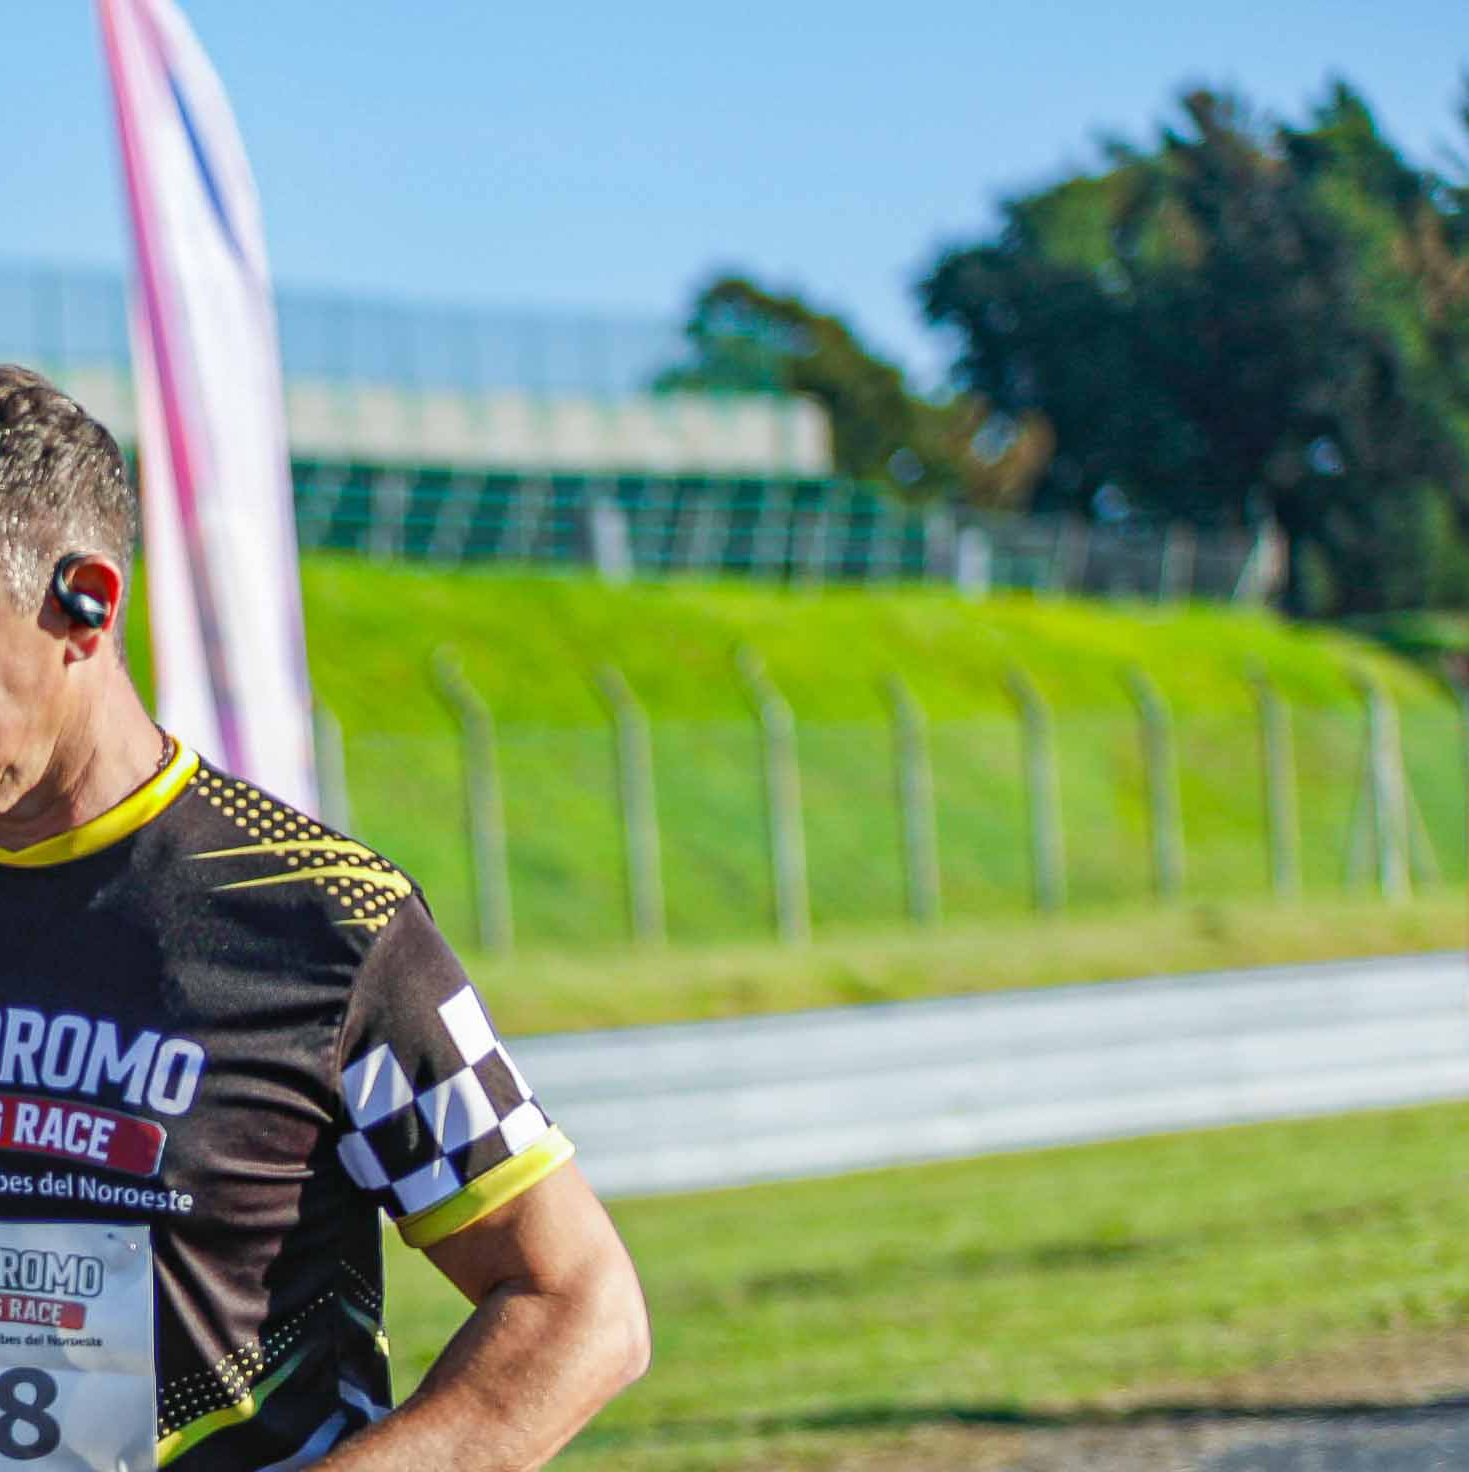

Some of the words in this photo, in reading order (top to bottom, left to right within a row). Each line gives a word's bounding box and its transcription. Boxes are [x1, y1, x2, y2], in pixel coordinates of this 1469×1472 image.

[12, 1103, 116, 1161] RACE
[38, 1171, 74, 1198] del
[77, 1175, 194, 1213] Noroeste
[9, 1299, 64, 1325] RACE
[25, 1335, 45, 1347] del
